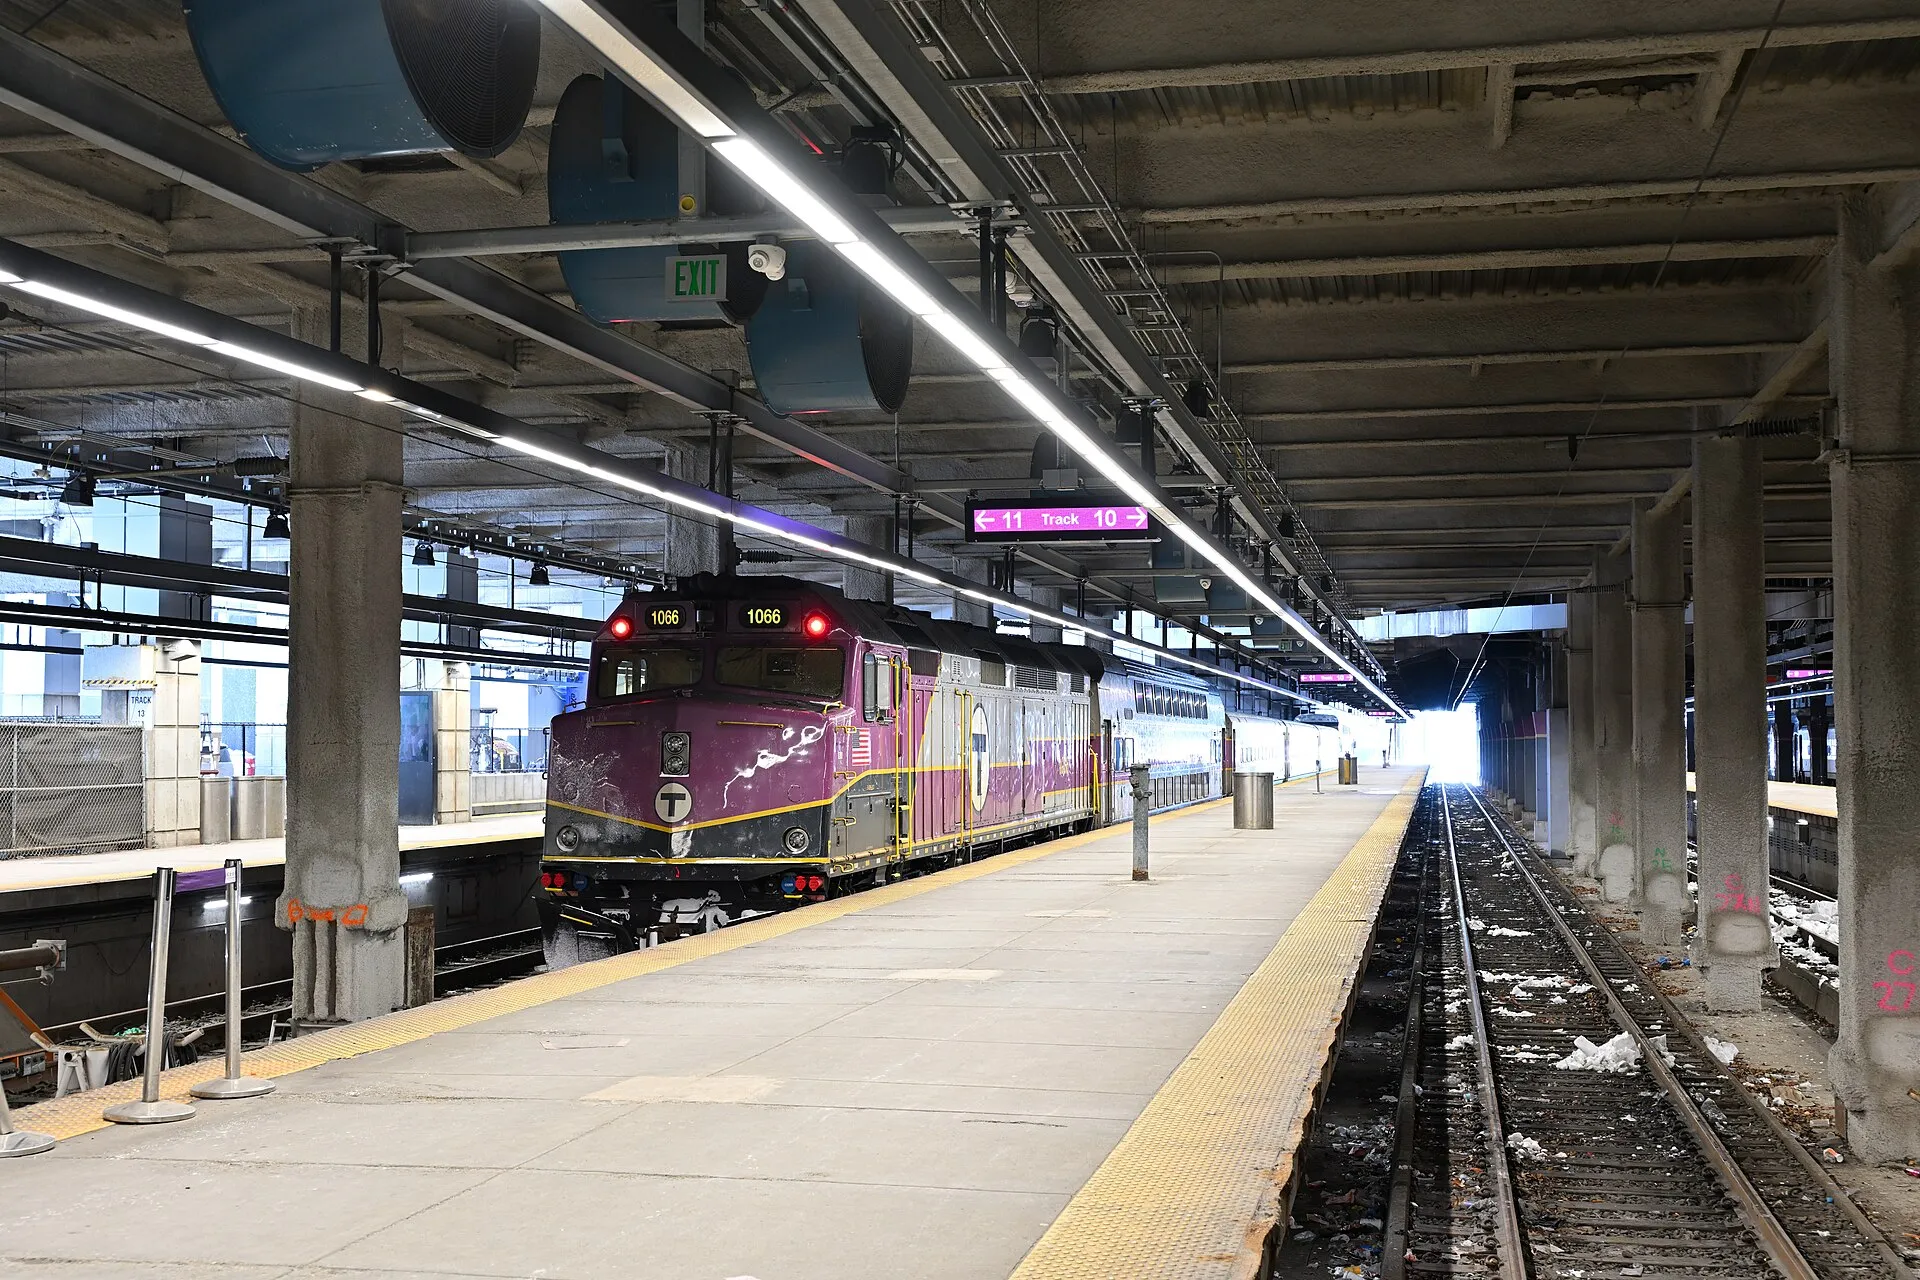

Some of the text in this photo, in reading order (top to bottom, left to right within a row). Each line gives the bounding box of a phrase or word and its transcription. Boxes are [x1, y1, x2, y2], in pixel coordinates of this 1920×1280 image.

[675, 260, 720, 296] EXIT
[1002, 509, 1117, 529] 11 Track 10
[651, 609, 680, 625] 1066
[747, 608, 781, 624] 1066
[131, 696, 152, 704] TRACK
[137, 709, 146, 718] 13
[660, 792, 686, 818] T
[1887, 949, 1916, 975] C
[1872, 981, 1917, 1011] 27
